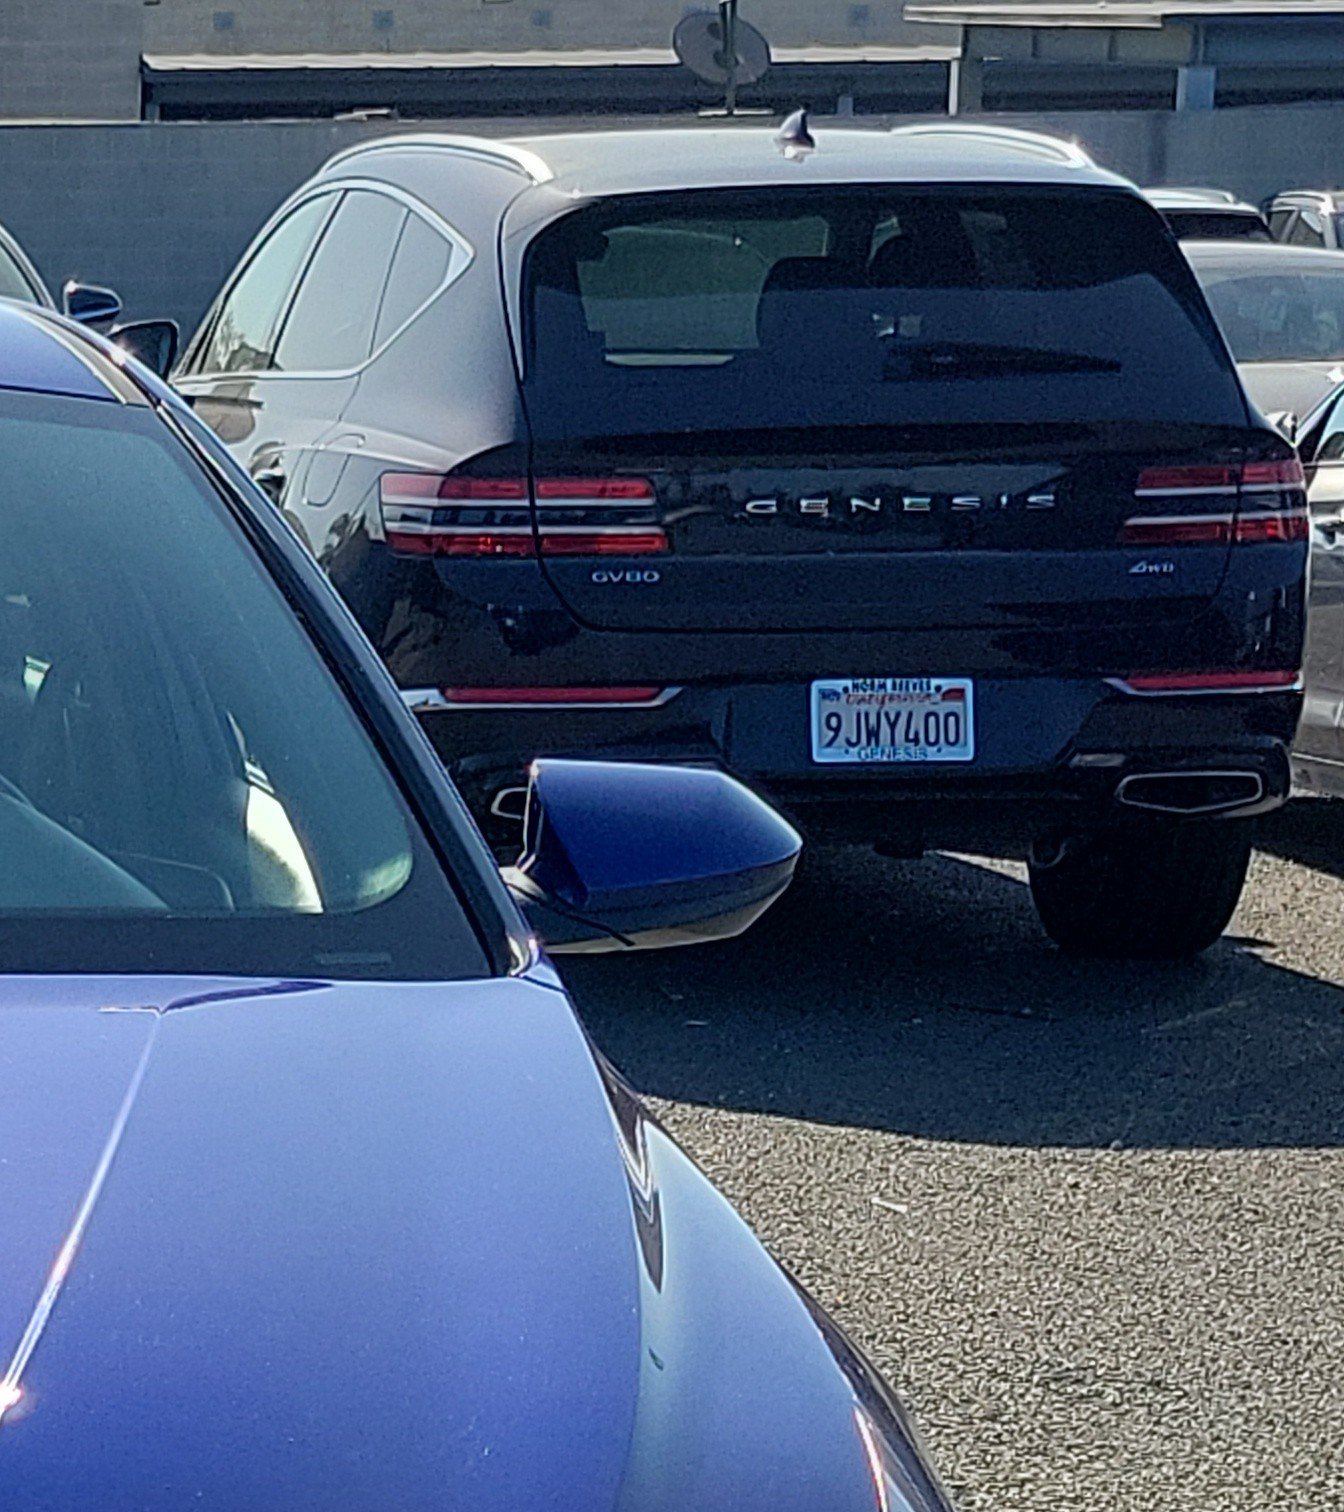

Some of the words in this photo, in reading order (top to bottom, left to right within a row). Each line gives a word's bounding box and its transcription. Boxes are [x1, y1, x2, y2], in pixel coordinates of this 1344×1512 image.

[745, 493, 1055, 515] GENESIS
[592, 569, 661, 583] GV80
[824, 711, 961, 748] 9JWY400
[856, 747, 929, 761] GENESIS
